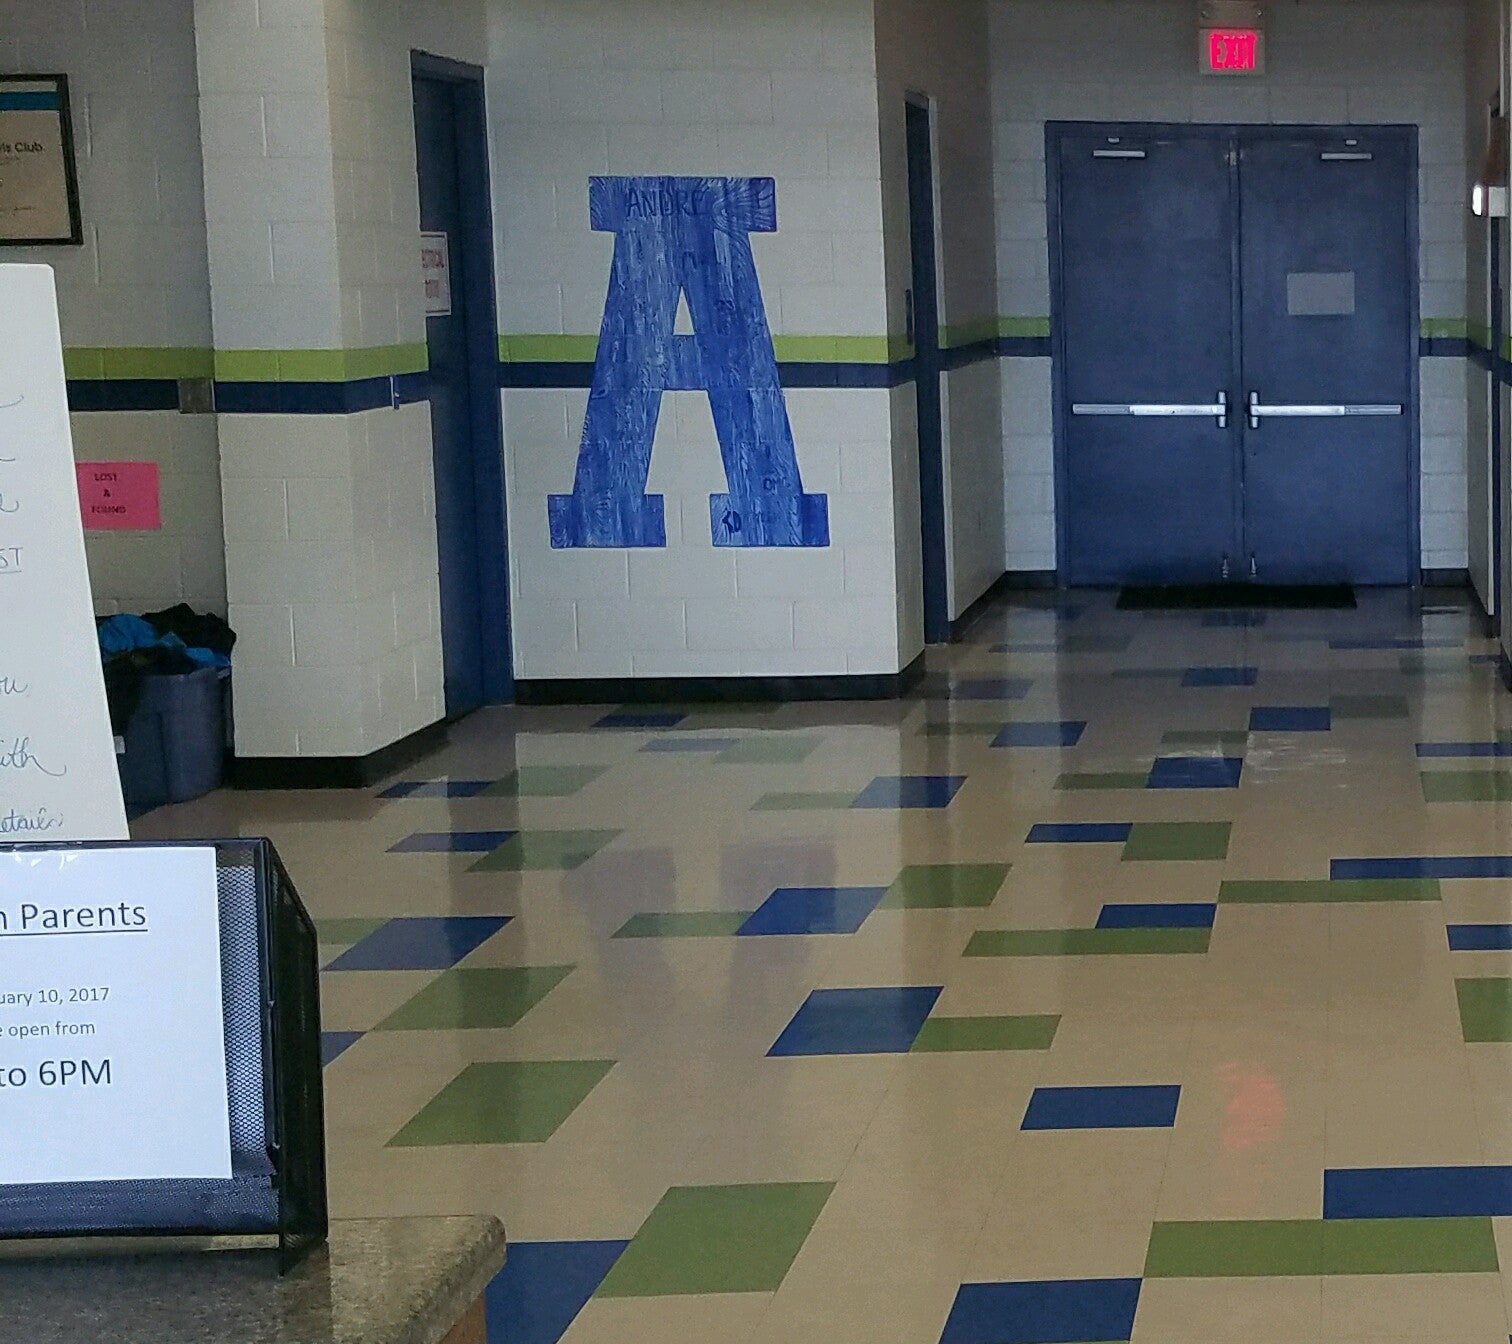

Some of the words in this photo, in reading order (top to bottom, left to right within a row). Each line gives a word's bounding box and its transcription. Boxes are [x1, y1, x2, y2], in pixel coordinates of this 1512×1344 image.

[1210, 32, 1256, 70] EXIT
[14, 141, 43, 152] Club
[547, 176, 830, 548] A
[21, 902, 146, 929] Parents
[38, 989, 63, 1005] 10,
[69, 987, 109, 1002] 2017
[8, 1024, 50, 1039] open
[55, 1020, 96, 1036] from
[39, 1059, 111, 1086] 6PM
